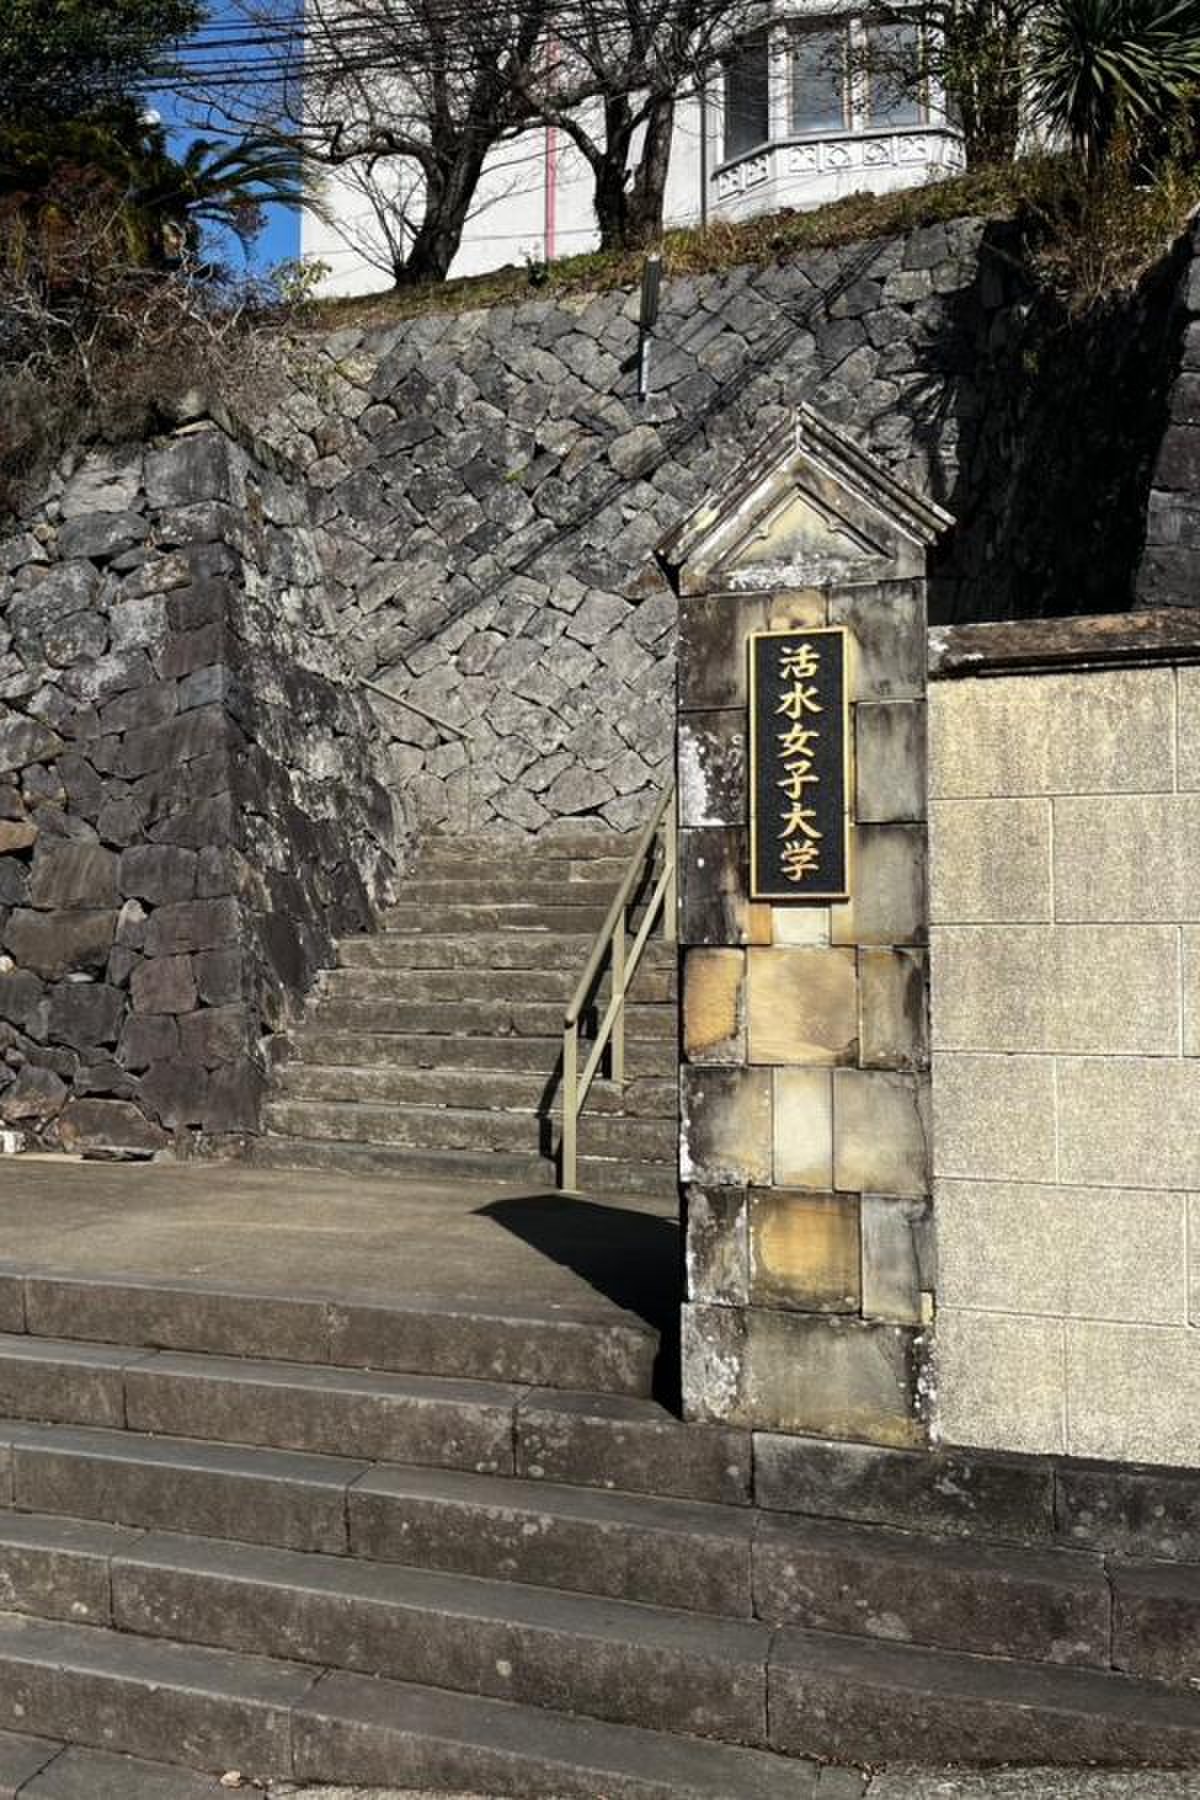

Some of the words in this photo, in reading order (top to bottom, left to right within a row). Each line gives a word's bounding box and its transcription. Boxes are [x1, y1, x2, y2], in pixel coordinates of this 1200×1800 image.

[775, 644, 824, 881] 活水女子大学
